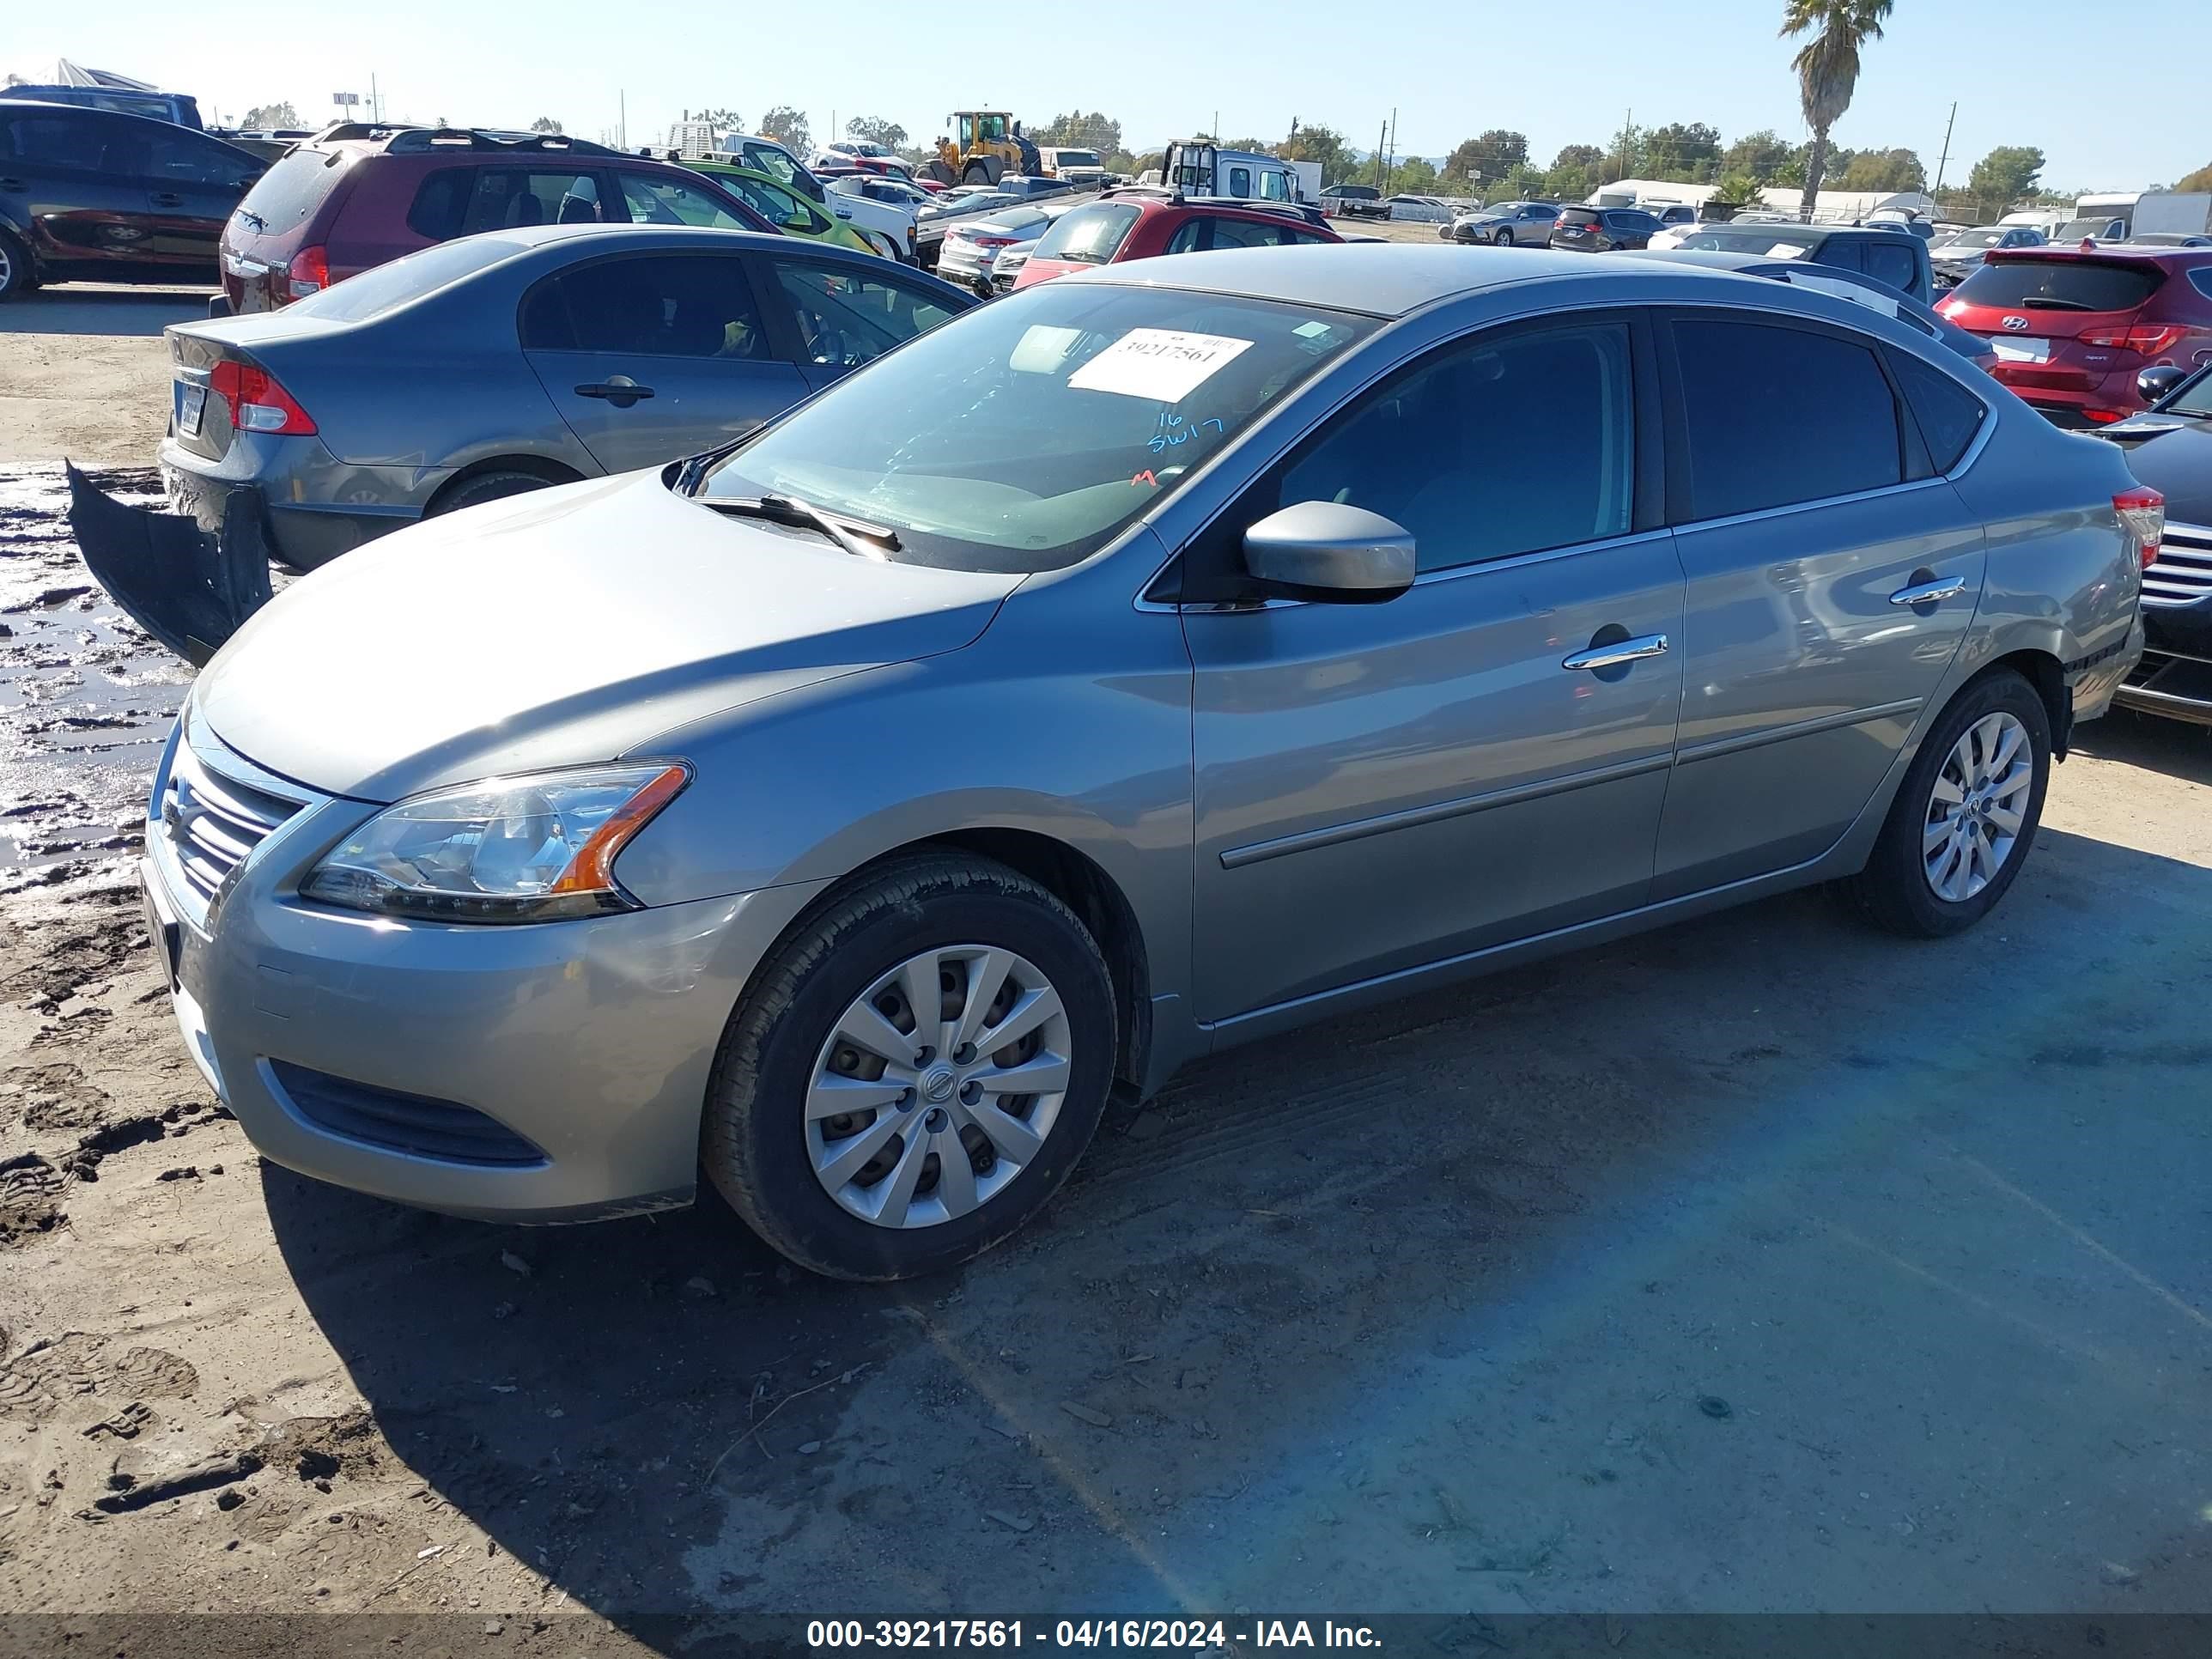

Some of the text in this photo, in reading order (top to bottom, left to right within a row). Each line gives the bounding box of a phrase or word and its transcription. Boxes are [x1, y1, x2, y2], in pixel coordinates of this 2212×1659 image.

[1118, 342, 1216, 362] 39217561
[1160, 412, 1182, 427] 16
[1131, 470, 1156, 487] M
